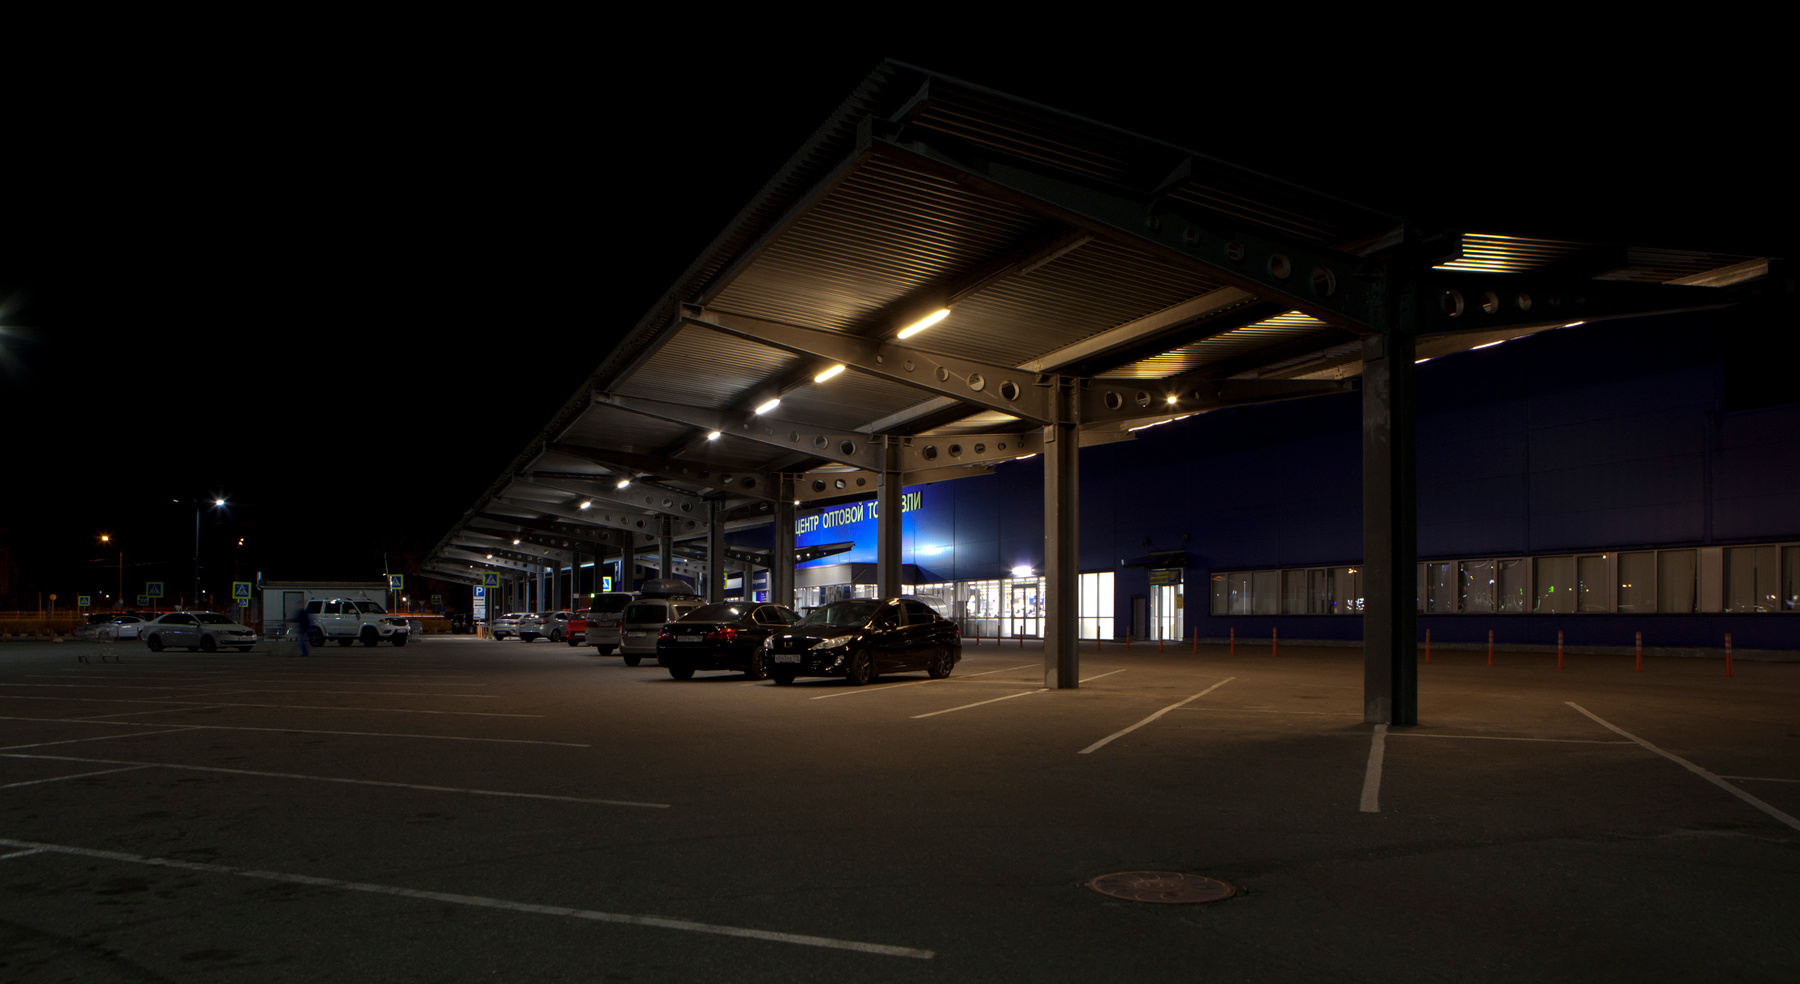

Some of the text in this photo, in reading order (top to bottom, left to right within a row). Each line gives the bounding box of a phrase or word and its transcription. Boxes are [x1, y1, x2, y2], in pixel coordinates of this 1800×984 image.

[795, 492, 921, 536] ЦЕНТР ОПТОВОЙ ТОВЛИ
[475, 586, 484, 596] P
